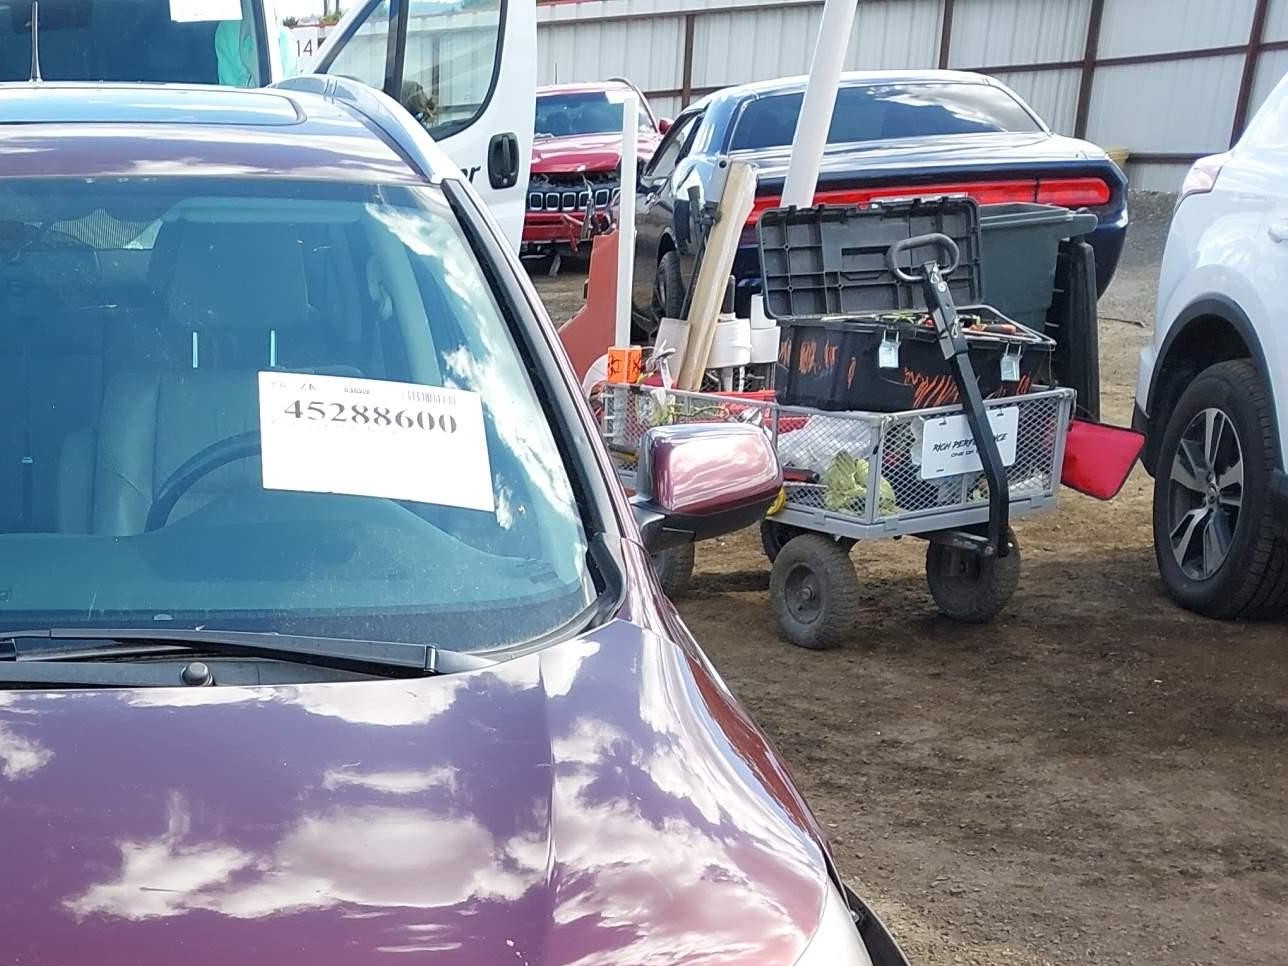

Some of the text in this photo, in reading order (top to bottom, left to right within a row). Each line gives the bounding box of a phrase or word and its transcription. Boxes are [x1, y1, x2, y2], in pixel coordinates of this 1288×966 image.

[296, 39, 313, 57] 14
[283, 399, 457, 434] 45288600
[933, 441, 951, 452] RICH
